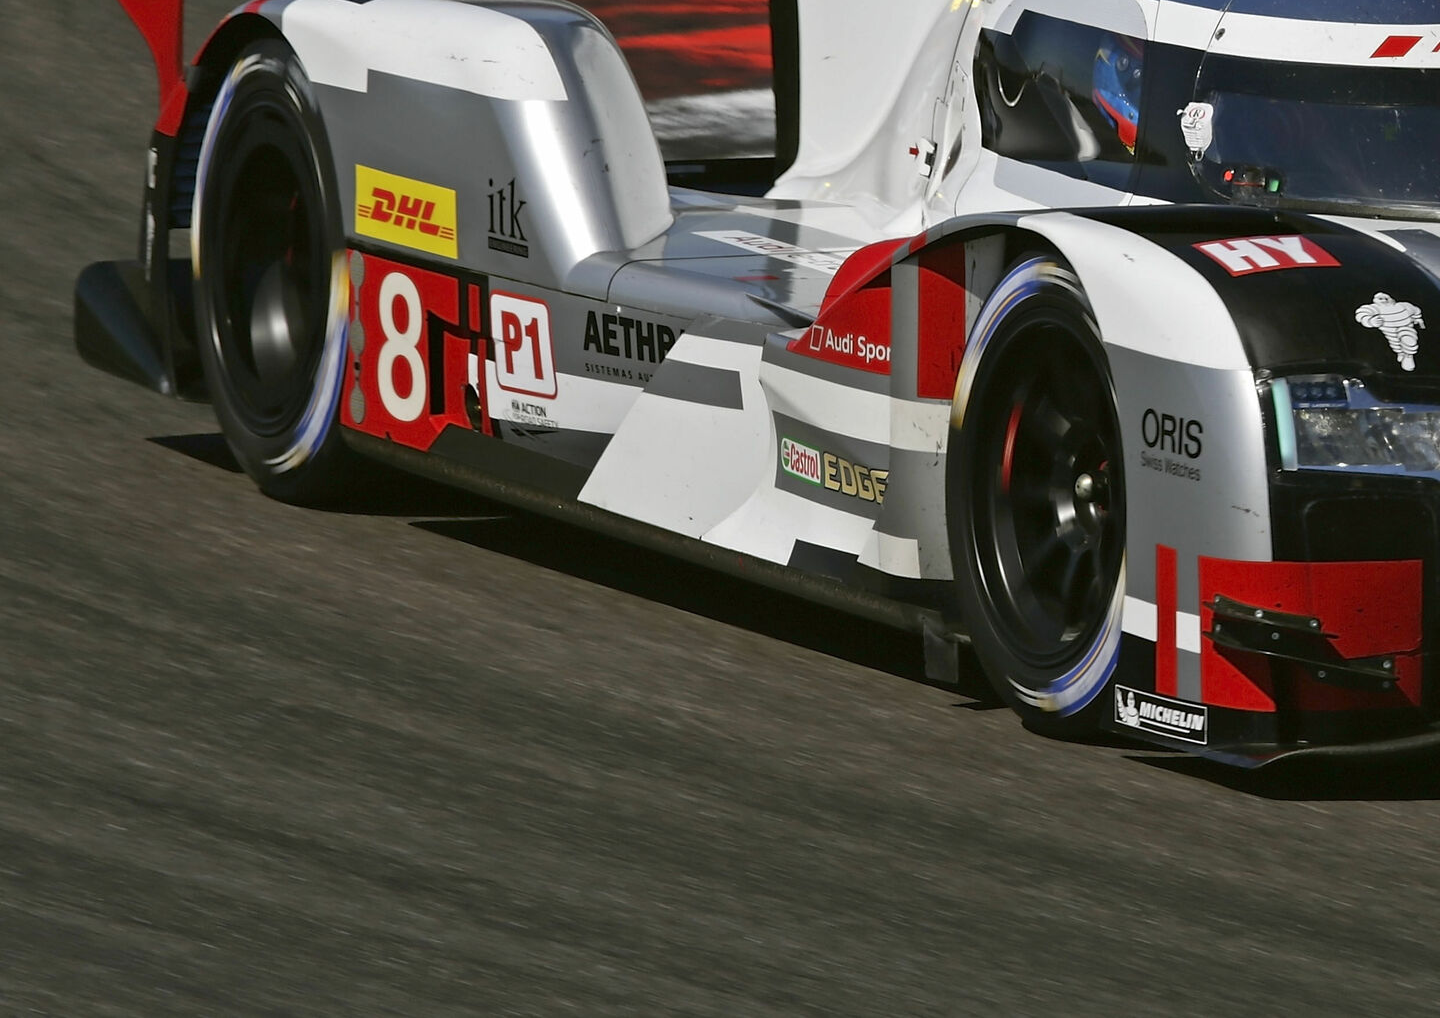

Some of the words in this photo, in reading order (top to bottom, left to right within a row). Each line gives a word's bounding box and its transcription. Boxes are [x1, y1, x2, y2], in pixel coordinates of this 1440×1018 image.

[371, 187, 441, 237] DHL
[488, 178, 528, 242] itk
[1203, 236, 1317, 272] HY
[377, 272, 428, 422] 8
[500, 310, 545, 380] P1
[825, 328, 854, 355] Audi
[857, 335, 891, 364] Spor
[584, 362, 633, 380] SISTEMAS
[521, 402, 547, 418] ACTION
[1142, 408, 1204, 459] ORIS
[790, 443, 820, 480] Castrol
[823, 452, 889, 505] EDGE
[1140, 450, 1163, 472] Swiss
[1164, 456, 1201, 482] Watches
[1139, 701, 1205, 731] MICHELIN
